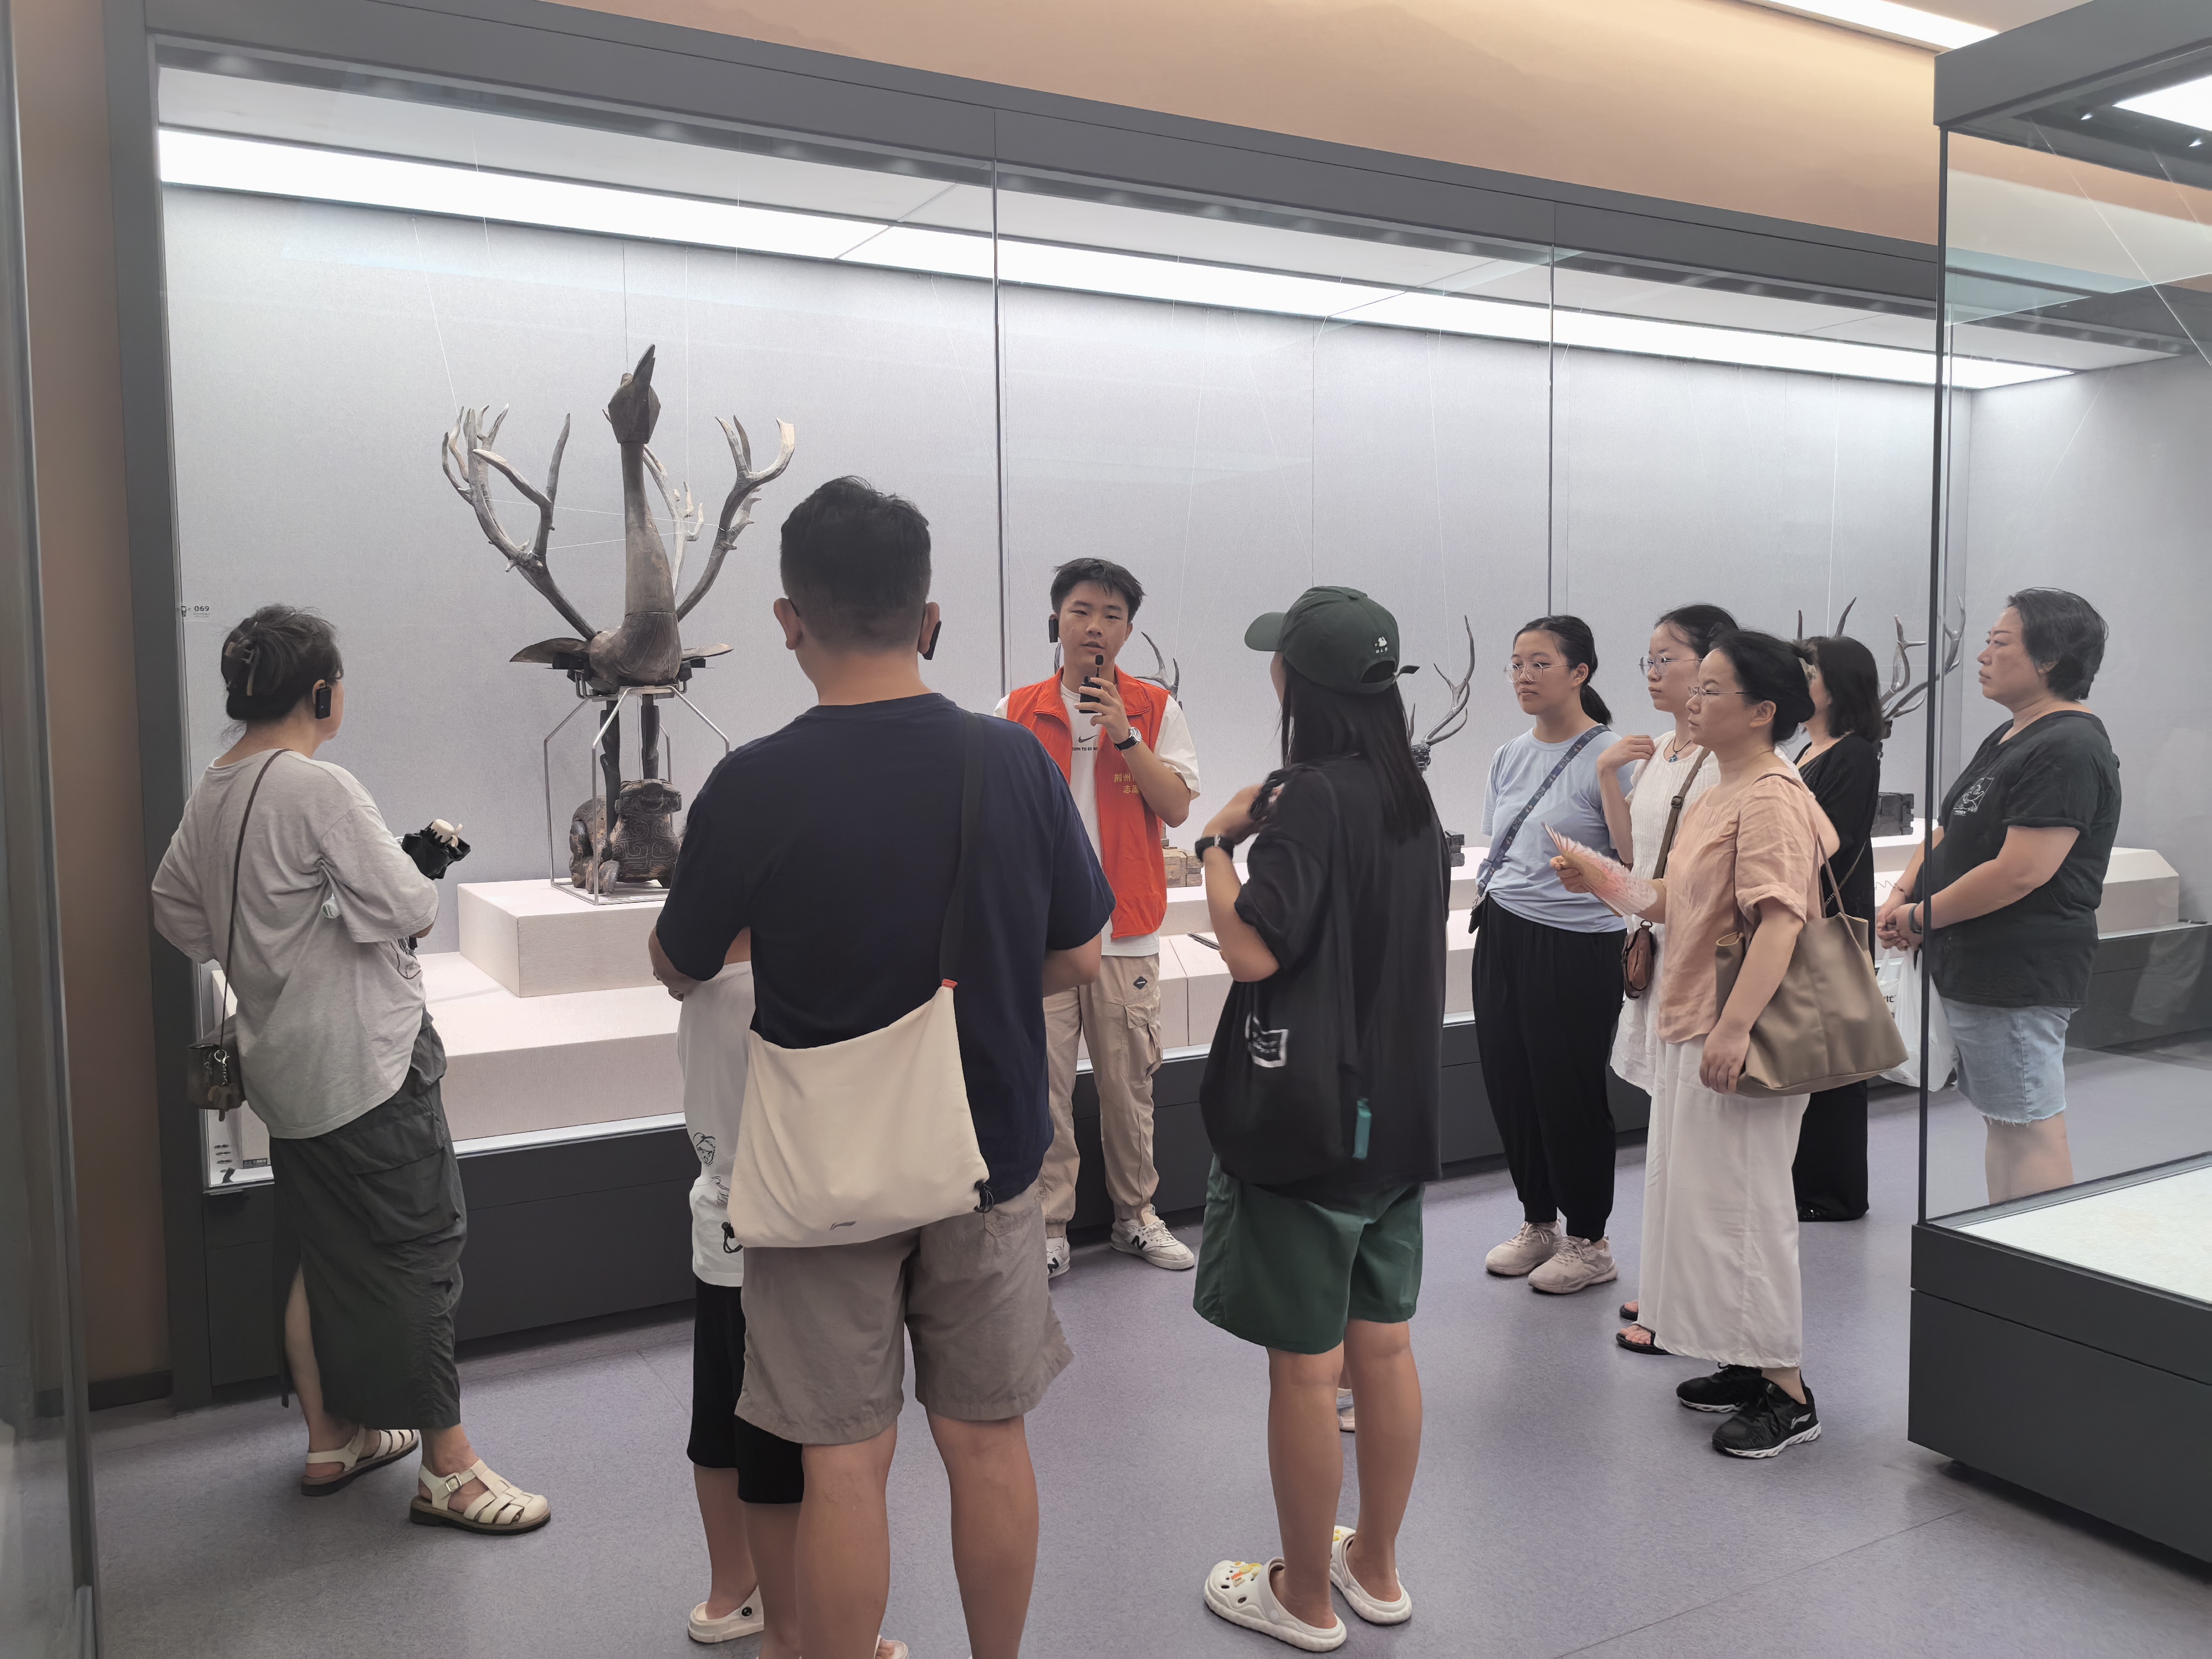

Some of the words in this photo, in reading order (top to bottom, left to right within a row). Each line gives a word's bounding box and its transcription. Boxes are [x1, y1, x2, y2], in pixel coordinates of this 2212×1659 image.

[1114, 773, 1135, 783] 荆州
[1123, 784, 1139, 793] 志愿
[1130, 1235, 1148, 1250] N
